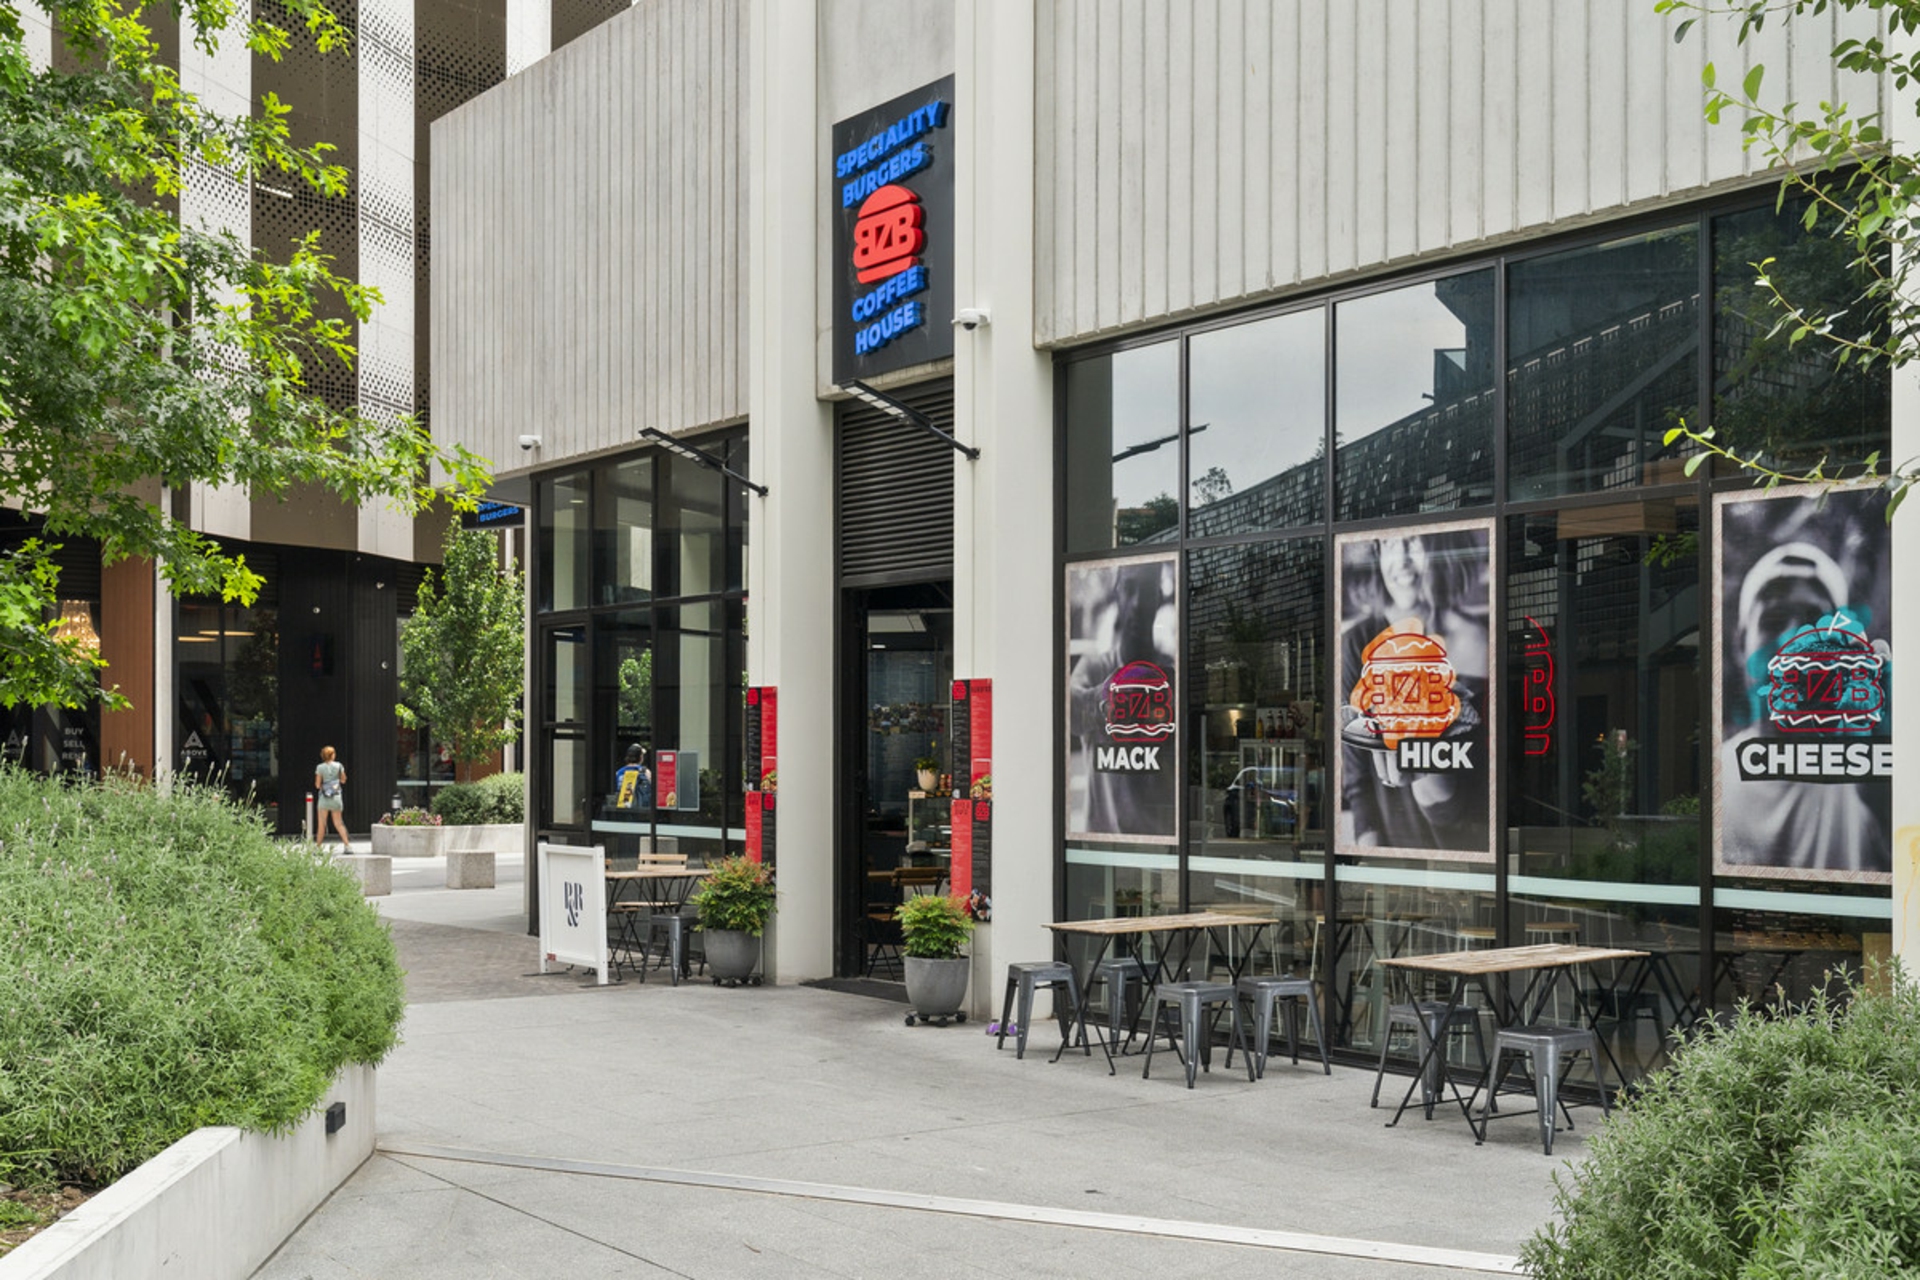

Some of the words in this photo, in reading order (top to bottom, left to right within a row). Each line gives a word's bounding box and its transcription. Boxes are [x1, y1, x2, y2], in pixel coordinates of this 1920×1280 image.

[836, 100, 949, 178] SPECIALITY
[842, 141, 930, 208] BURGERS
[852, 265, 926, 322] COFFEE
[855, 301, 921, 355] HOUSE
[480, 506, 519, 522] BURGERS
[63, 739, 84, 748] SELL
[64, 727, 84, 735] BUY
[1097, 746, 1160, 771] MACK
[1400, 742, 1473, 769] HICK
[1741, 743, 1893, 776] CHEESE
